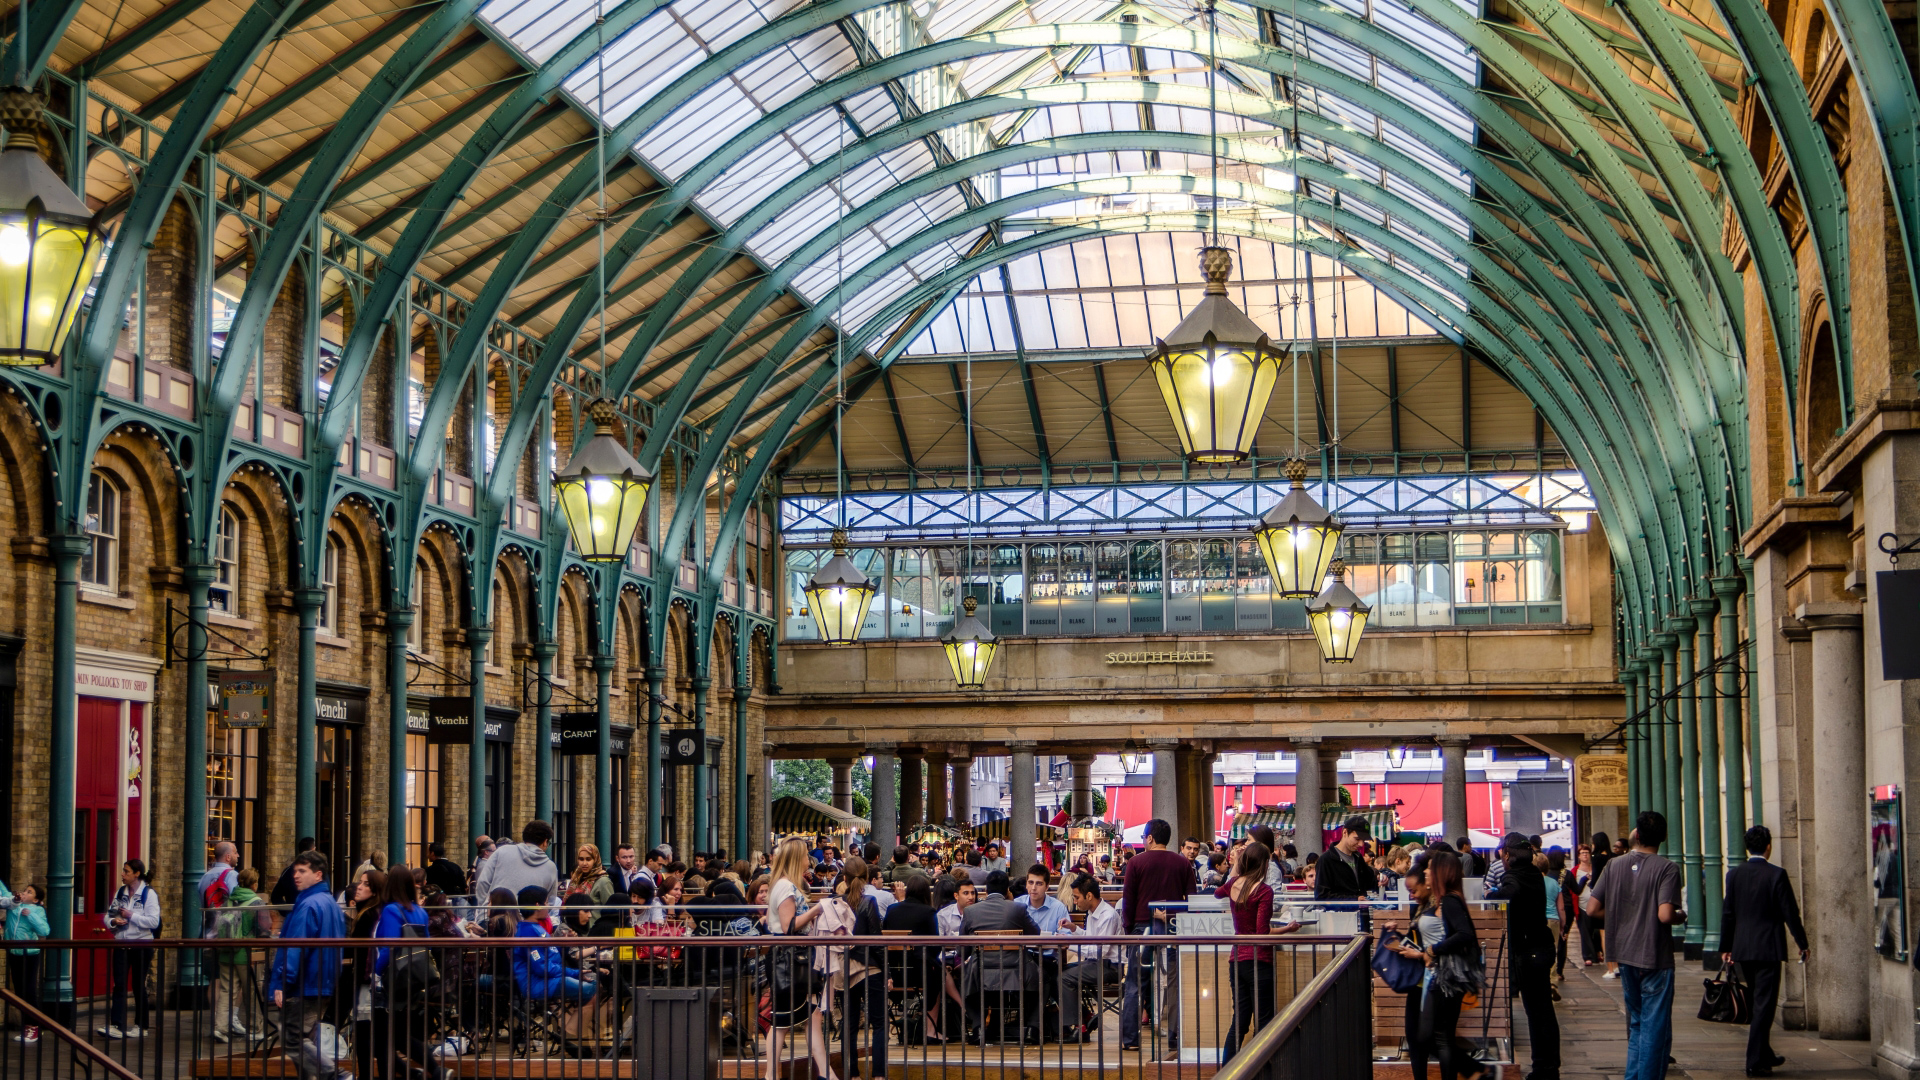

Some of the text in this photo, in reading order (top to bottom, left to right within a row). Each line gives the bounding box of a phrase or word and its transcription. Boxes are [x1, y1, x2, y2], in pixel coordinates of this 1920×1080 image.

[1107, 650, 1212, 664] SOUTH HALL
[121, 678, 133, 691] TOY
[133, 680, 149, 692] SHOP
[315, 697, 347, 720] Venchi
[435, 716, 469, 725] Venchi
[698, 920, 760, 937] SHACK
[1169, 917, 1233, 935] SHAKE
